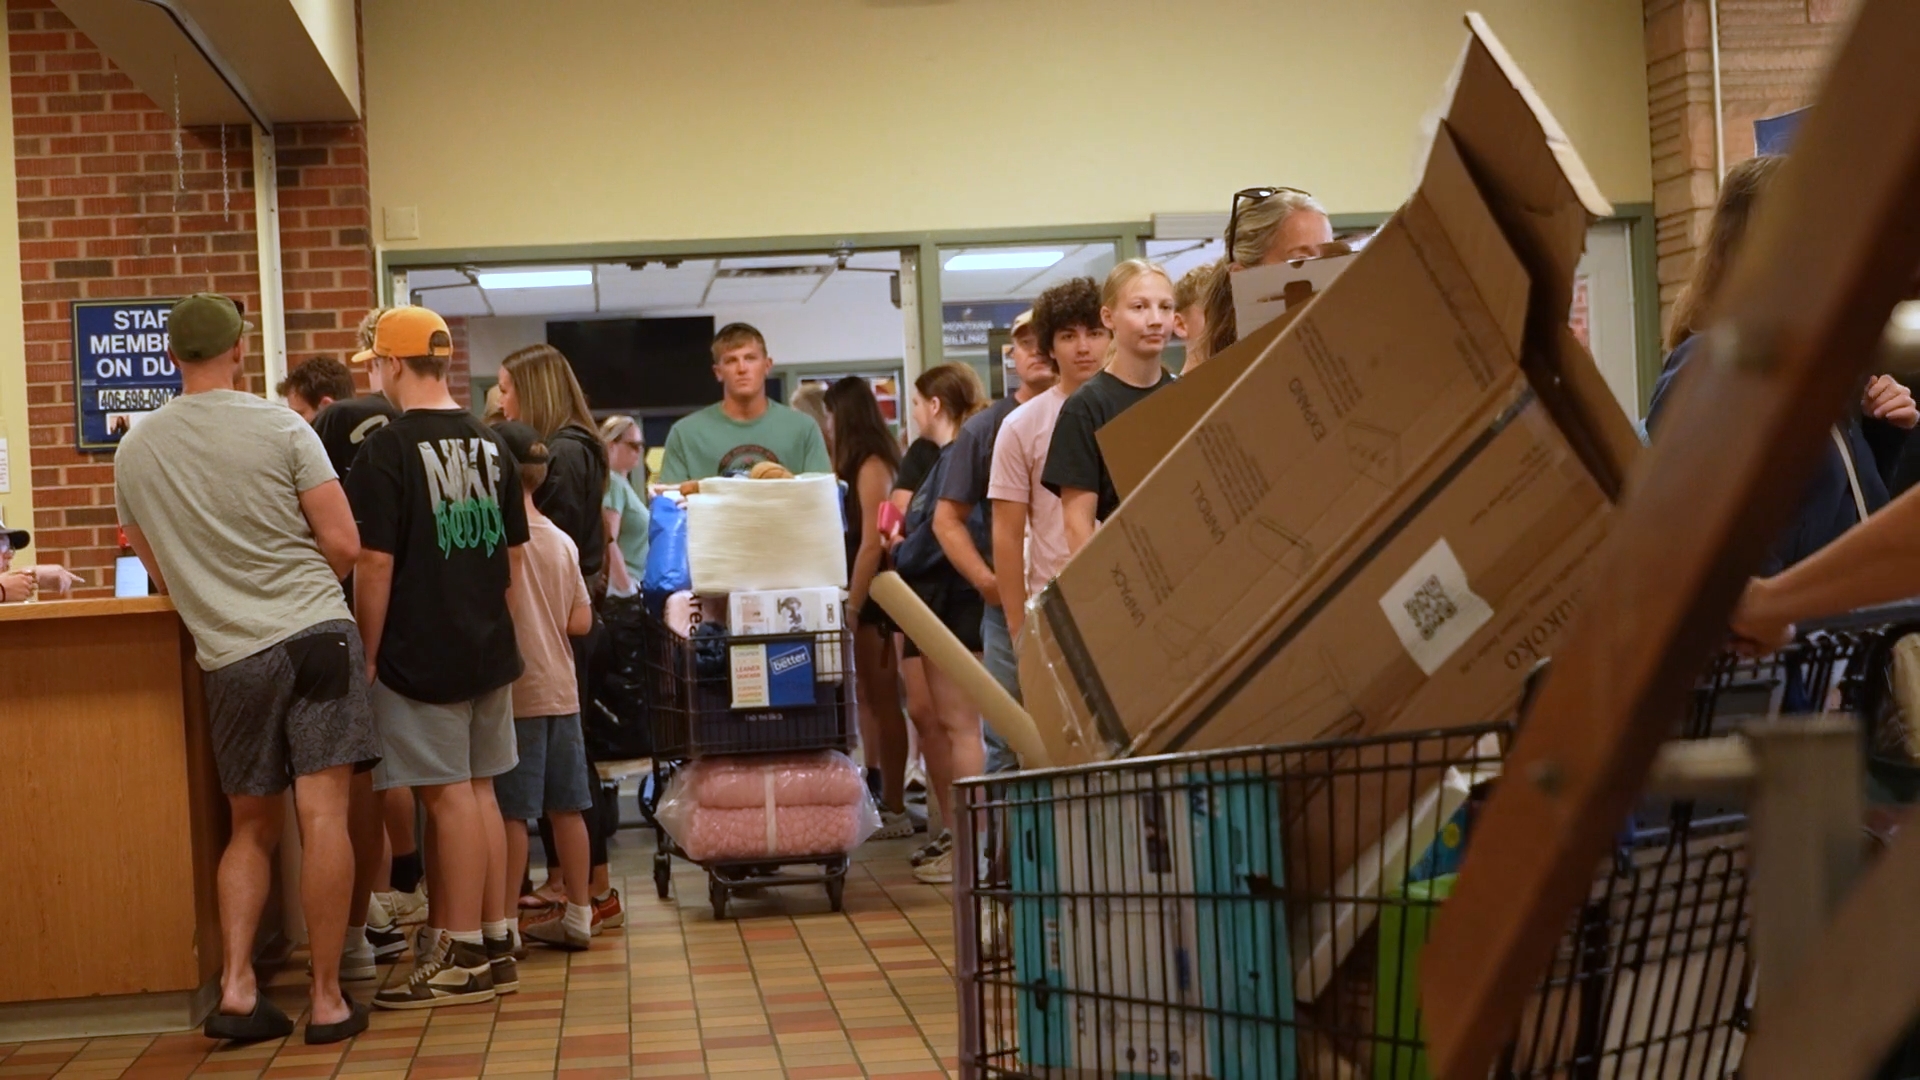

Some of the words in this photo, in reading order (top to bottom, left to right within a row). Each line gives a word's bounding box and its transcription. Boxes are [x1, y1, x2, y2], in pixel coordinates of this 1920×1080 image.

[113, 309, 172, 330] STAF
[96, 358, 132, 378] ON
[142, 357, 175, 377] DU
[100, 388, 176, 410] 406-698-090
[1288, 375, 1327, 442] EXPAND
[1190, 479, 1226, 545] UNROLL
[1110, 562, 1146, 629] UNPACK
[772, 652, 806, 671] better
